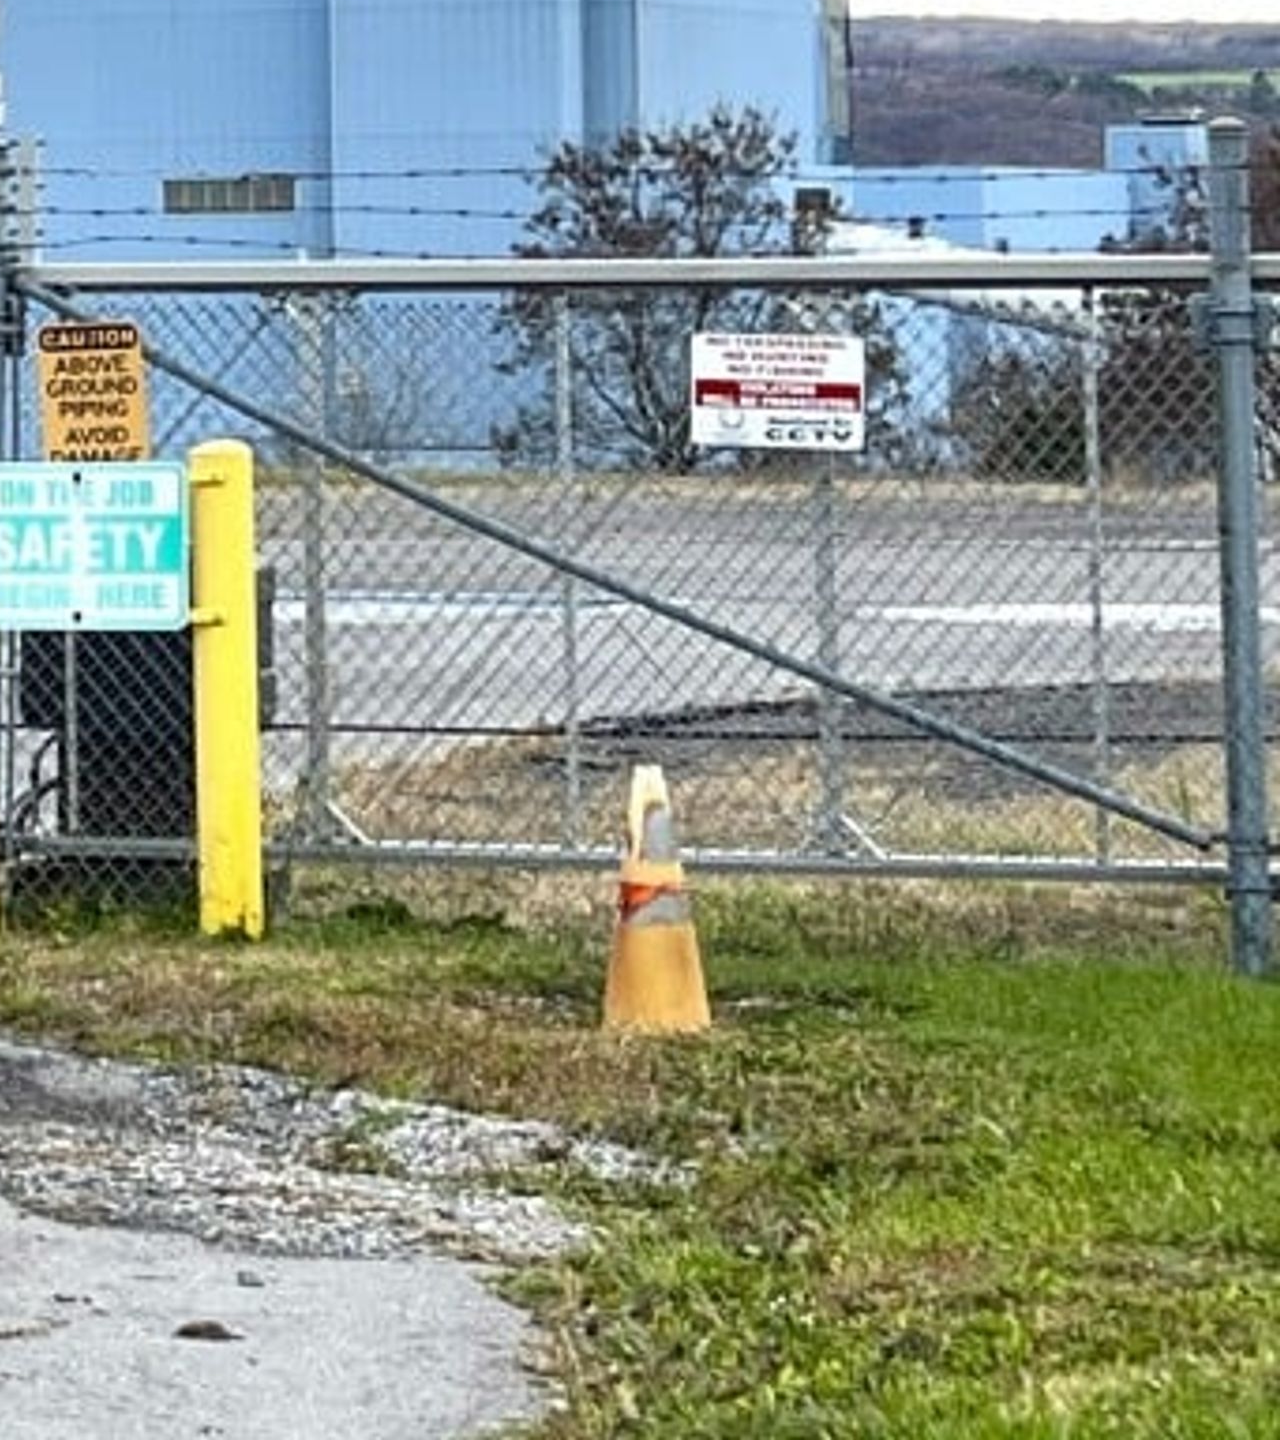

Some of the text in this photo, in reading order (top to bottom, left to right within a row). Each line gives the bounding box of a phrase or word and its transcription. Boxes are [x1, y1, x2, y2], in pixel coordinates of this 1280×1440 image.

[41, 329, 136, 347] CAUTION
[54, 354, 130, 376] ABOVE
[46, 375, 138, 399] GROUND
[58, 399, 130, 418] PIPING
[64, 426, 130, 445] AVOID
[765, 427, 853, 442] CCTV
[50, 446, 144, 462] DAMAGE
[0, 479, 154, 506] ON THE JOB
[96, 581, 170, 609] HERE
